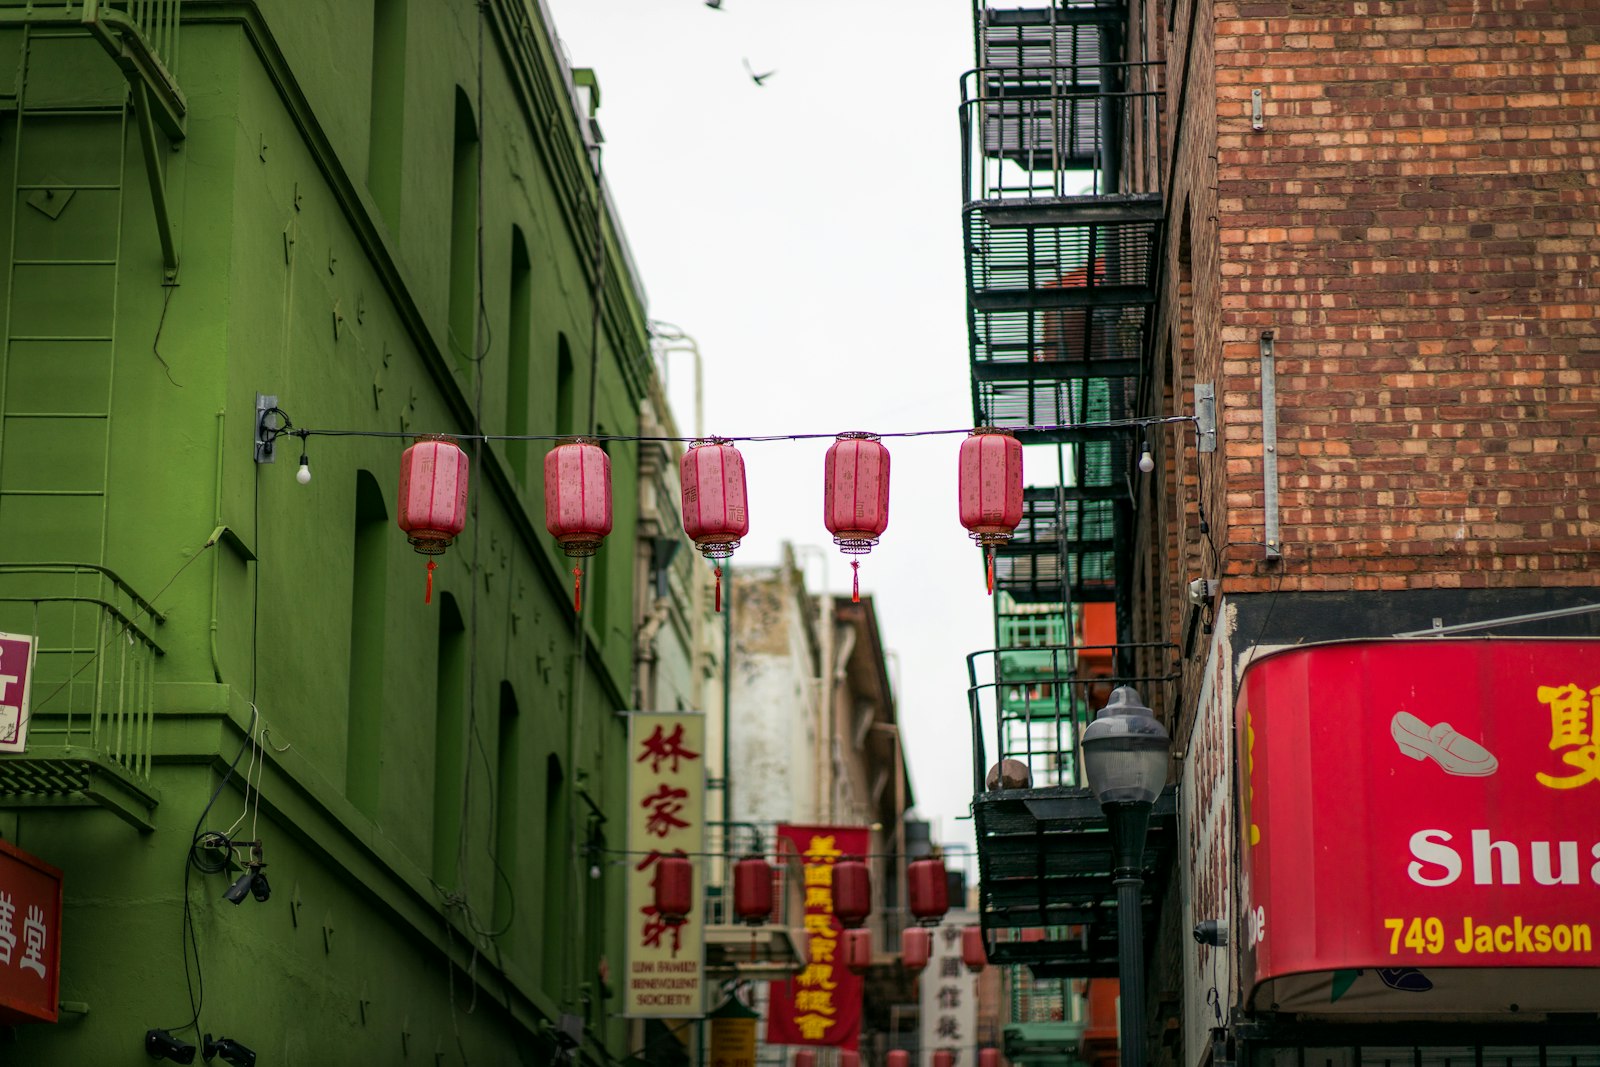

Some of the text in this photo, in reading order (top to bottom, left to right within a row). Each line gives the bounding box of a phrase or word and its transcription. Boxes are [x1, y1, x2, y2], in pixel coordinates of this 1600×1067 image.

[1407, 828, 1600, 887] Shu
[1384, 915, 1593, 955] 749 Jackson
[636, 994, 692, 1006] SOCIETY
